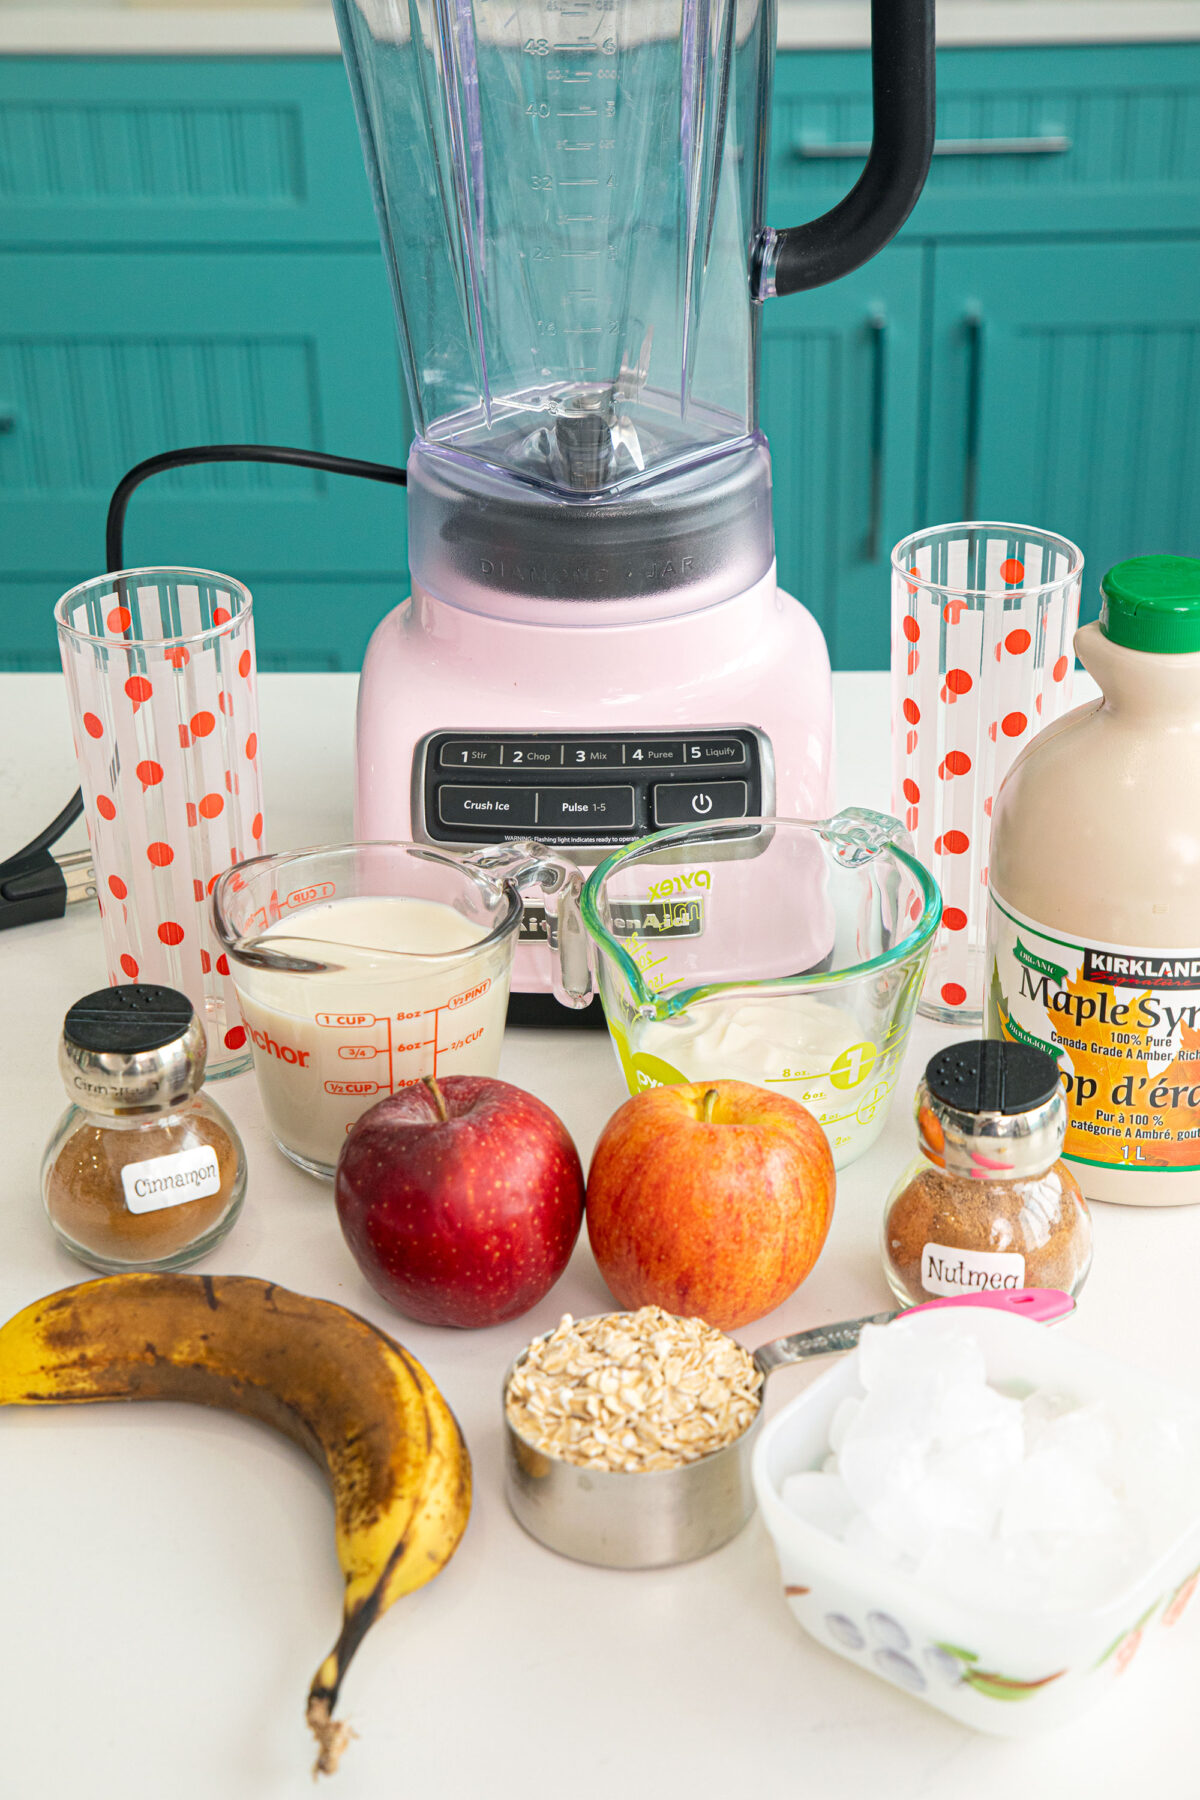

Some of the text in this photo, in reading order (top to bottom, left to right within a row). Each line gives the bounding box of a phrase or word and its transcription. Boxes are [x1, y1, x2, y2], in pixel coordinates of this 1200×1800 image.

[524, 37, 616, 56] 48 6
[525, 101, 616, 118] 40 5
[531, 175, 553, 191] 32
[646, 556, 695, 578] JAR
[461, 746, 735, 763] 1 Stir 2 Chop 3 Mix 4 Puree 5 Liquify
[464, 800, 606, 812] Crush Ice Pulse 1-5
[595, 836, 611, 844] ready
[1019, 949, 1057, 975] ORGANIC
[1088, 970, 1200, 989] Signature
[465, 982, 487, 1002] PINT
[1018, 965, 1130, 1028] Maple
[324, 1015, 366, 1026] 1 CUP
[396, 1011, 422, 1021] 8oz
[465, 1027, 484, 1045] CUP
[1111, 1031, 1172, 1047] 100% Pure
[349, 1048, 367, 1057] 3/4
[397, 1042, 422, 1052] 6oz
[1050, 1031, 1088, 1051] Canada
[1090, 1043, 1123, 1058] Grade
[1126, 1048, 1133, 1059] A
[1136, 1048, 1174, 1062] Amber,
[782, 1068, 791, 1078] 8
[330, 1083, 373, 1093] 1/2 CUP
[802, 1091, 811, 1101] 6
[1096, 1110, 1164, 1126] Pur à 100 %
[1071, 1118, 1122, 1137] catégorie
[1125, 1127, 1132, 1138] A
[1135, 1127, 1174, 1141] Ambré,
[1121, 1145, 1146, 1160] 1 L
[134, 1163, 217, 1199] Cinnamon
